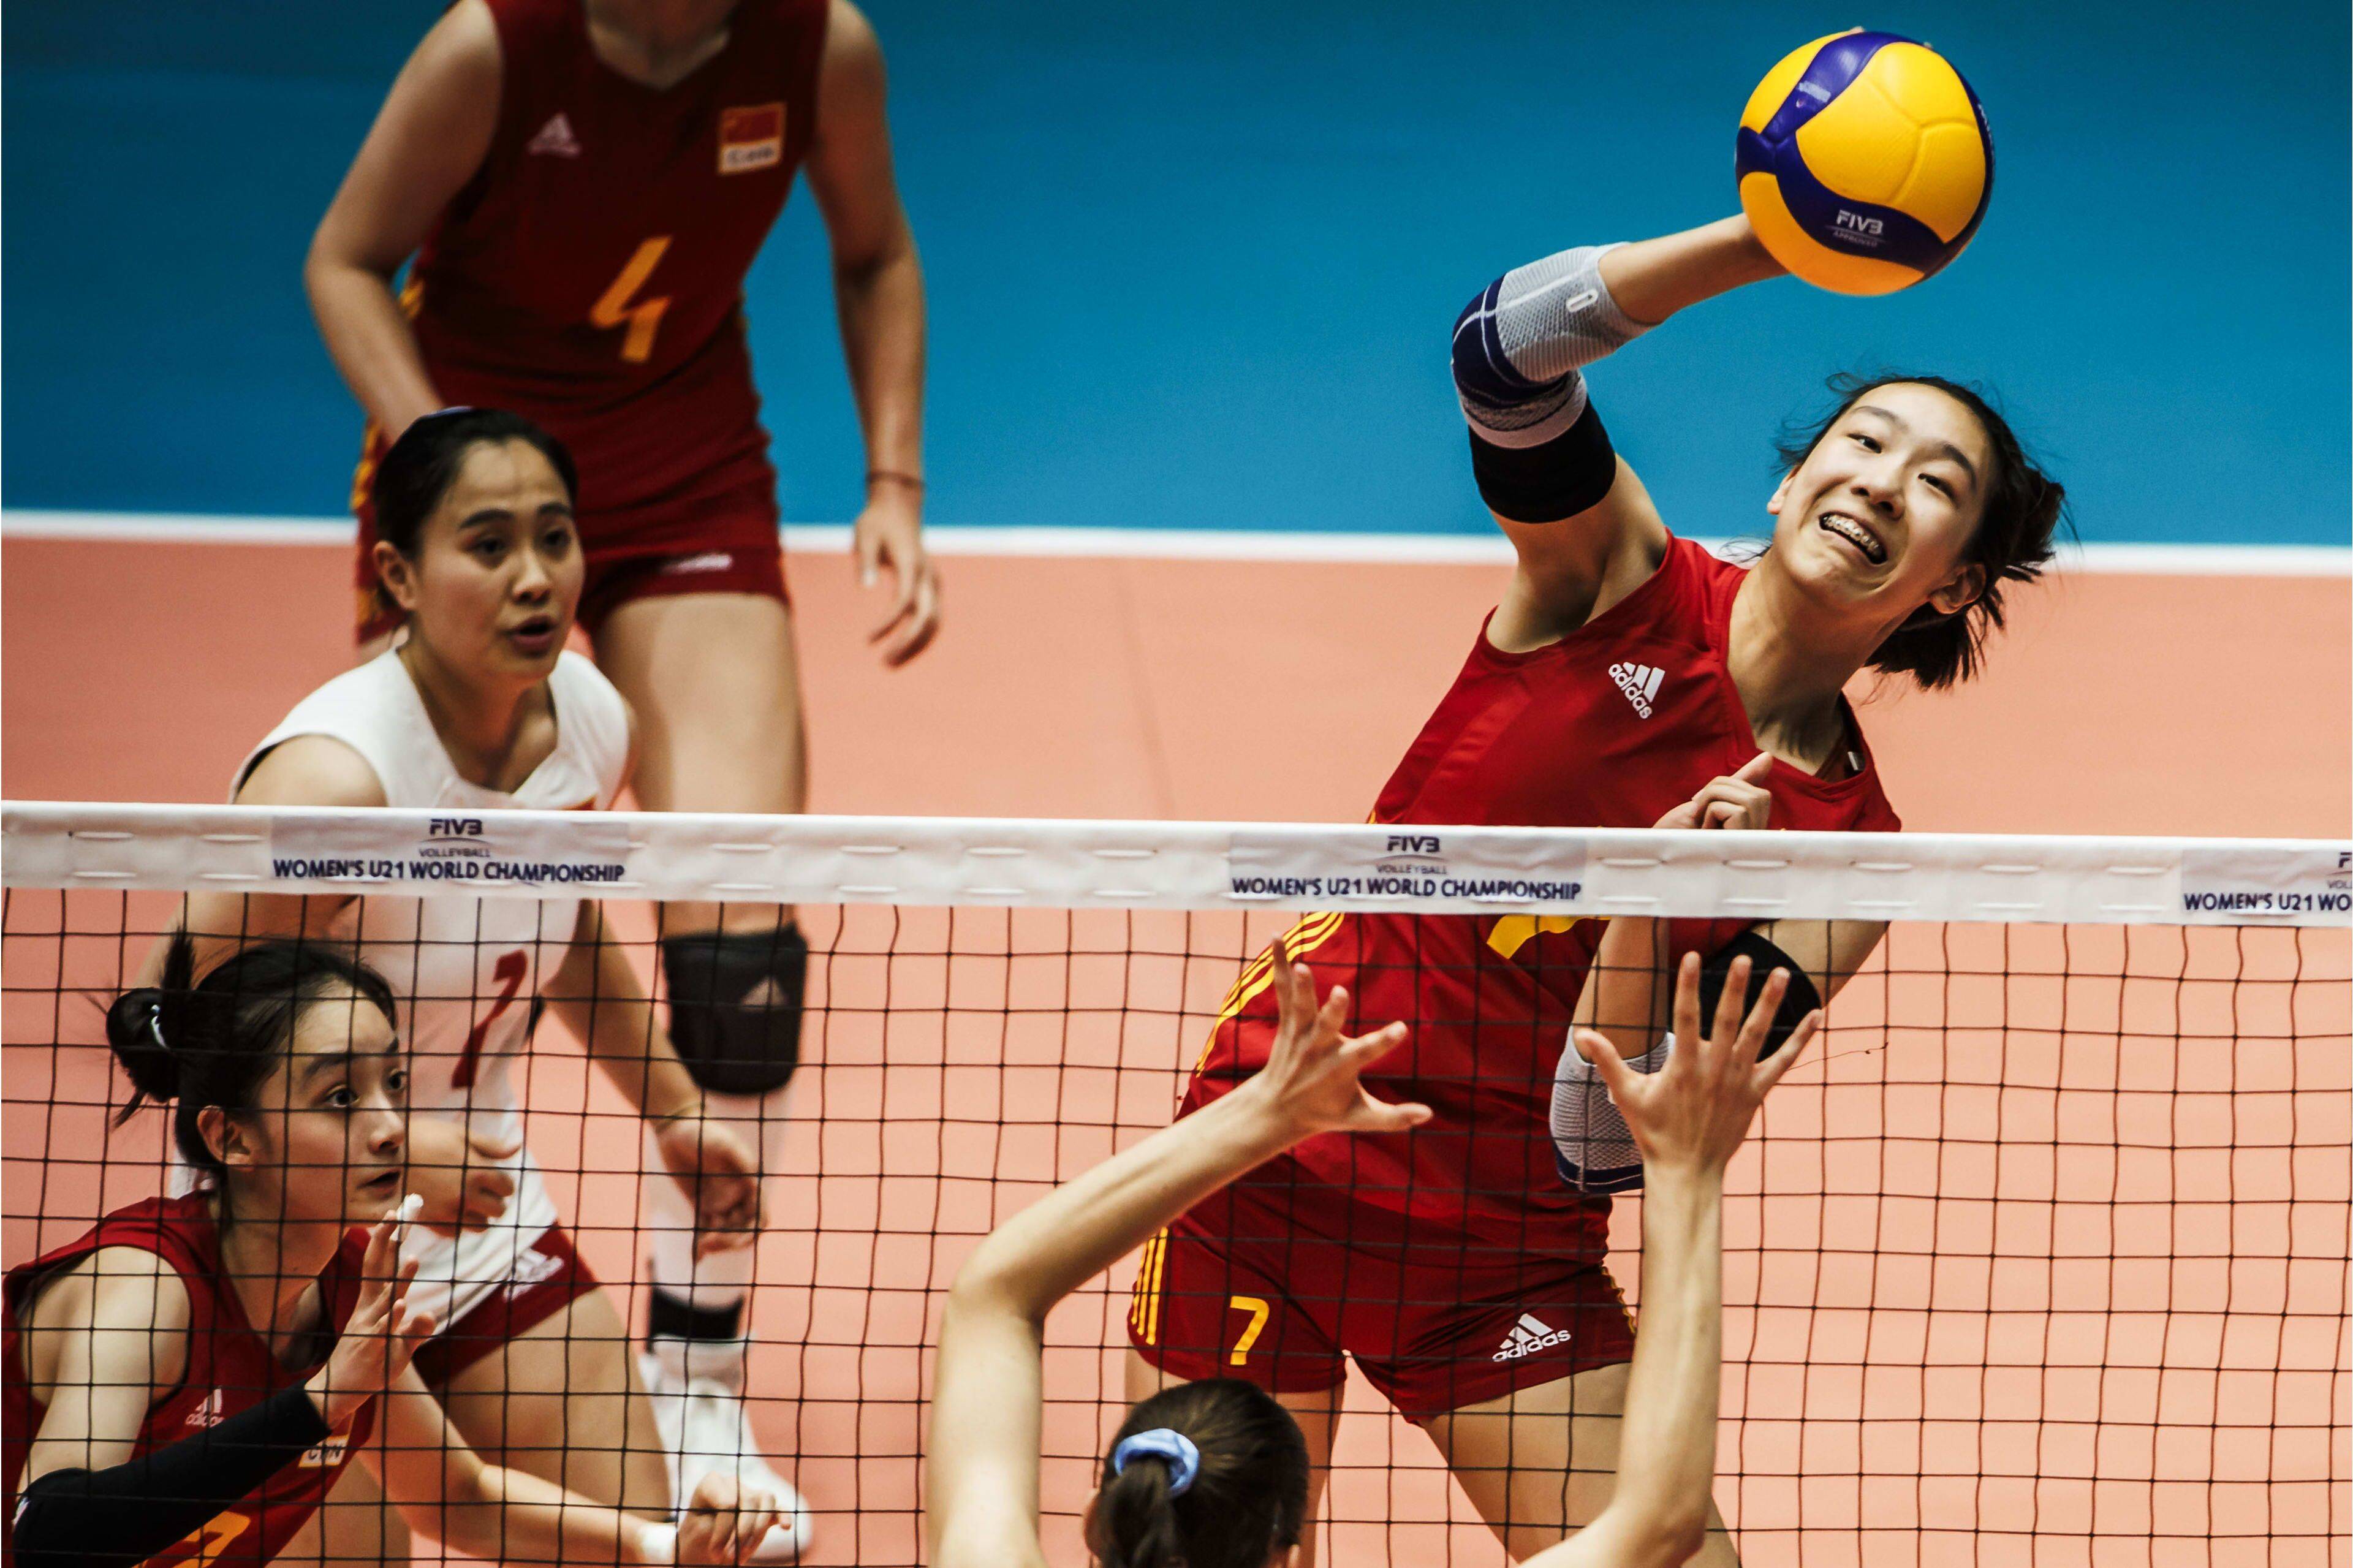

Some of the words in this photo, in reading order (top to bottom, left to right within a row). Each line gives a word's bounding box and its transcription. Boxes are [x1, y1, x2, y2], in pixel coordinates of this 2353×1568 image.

[589, 235, 672, 363] 4
[1608, 663, 1653, 719] adidas
[419, 848, 490, 857] VOLLEYBALL
[273, 859, 364, 877] WOMEN'S
[369, 860, 404, 879] U21
[409, 861, 479, 879] WORLD
[483, 862, 624, 882] CHAMPIONSHIP
[1376, 865, 1447, 874] VOLLEYBALL
[1232, 877, 1321, 895] WOMEN'S
[1327, 878, 1362, 895] U21
[1366, 877, 1436, 896] WORLD
[1441, 879, 1582, 900] CHAMPIONSHIP
[2184, 892, 2272, 911] WOMEN'S
[2279, 893, 2312, 911] U21
[2317, 893, 2352, 911] WO
[1229, 1295, 1270, 1365] 7
[1491, 1330, 1572, 1362] adidas
